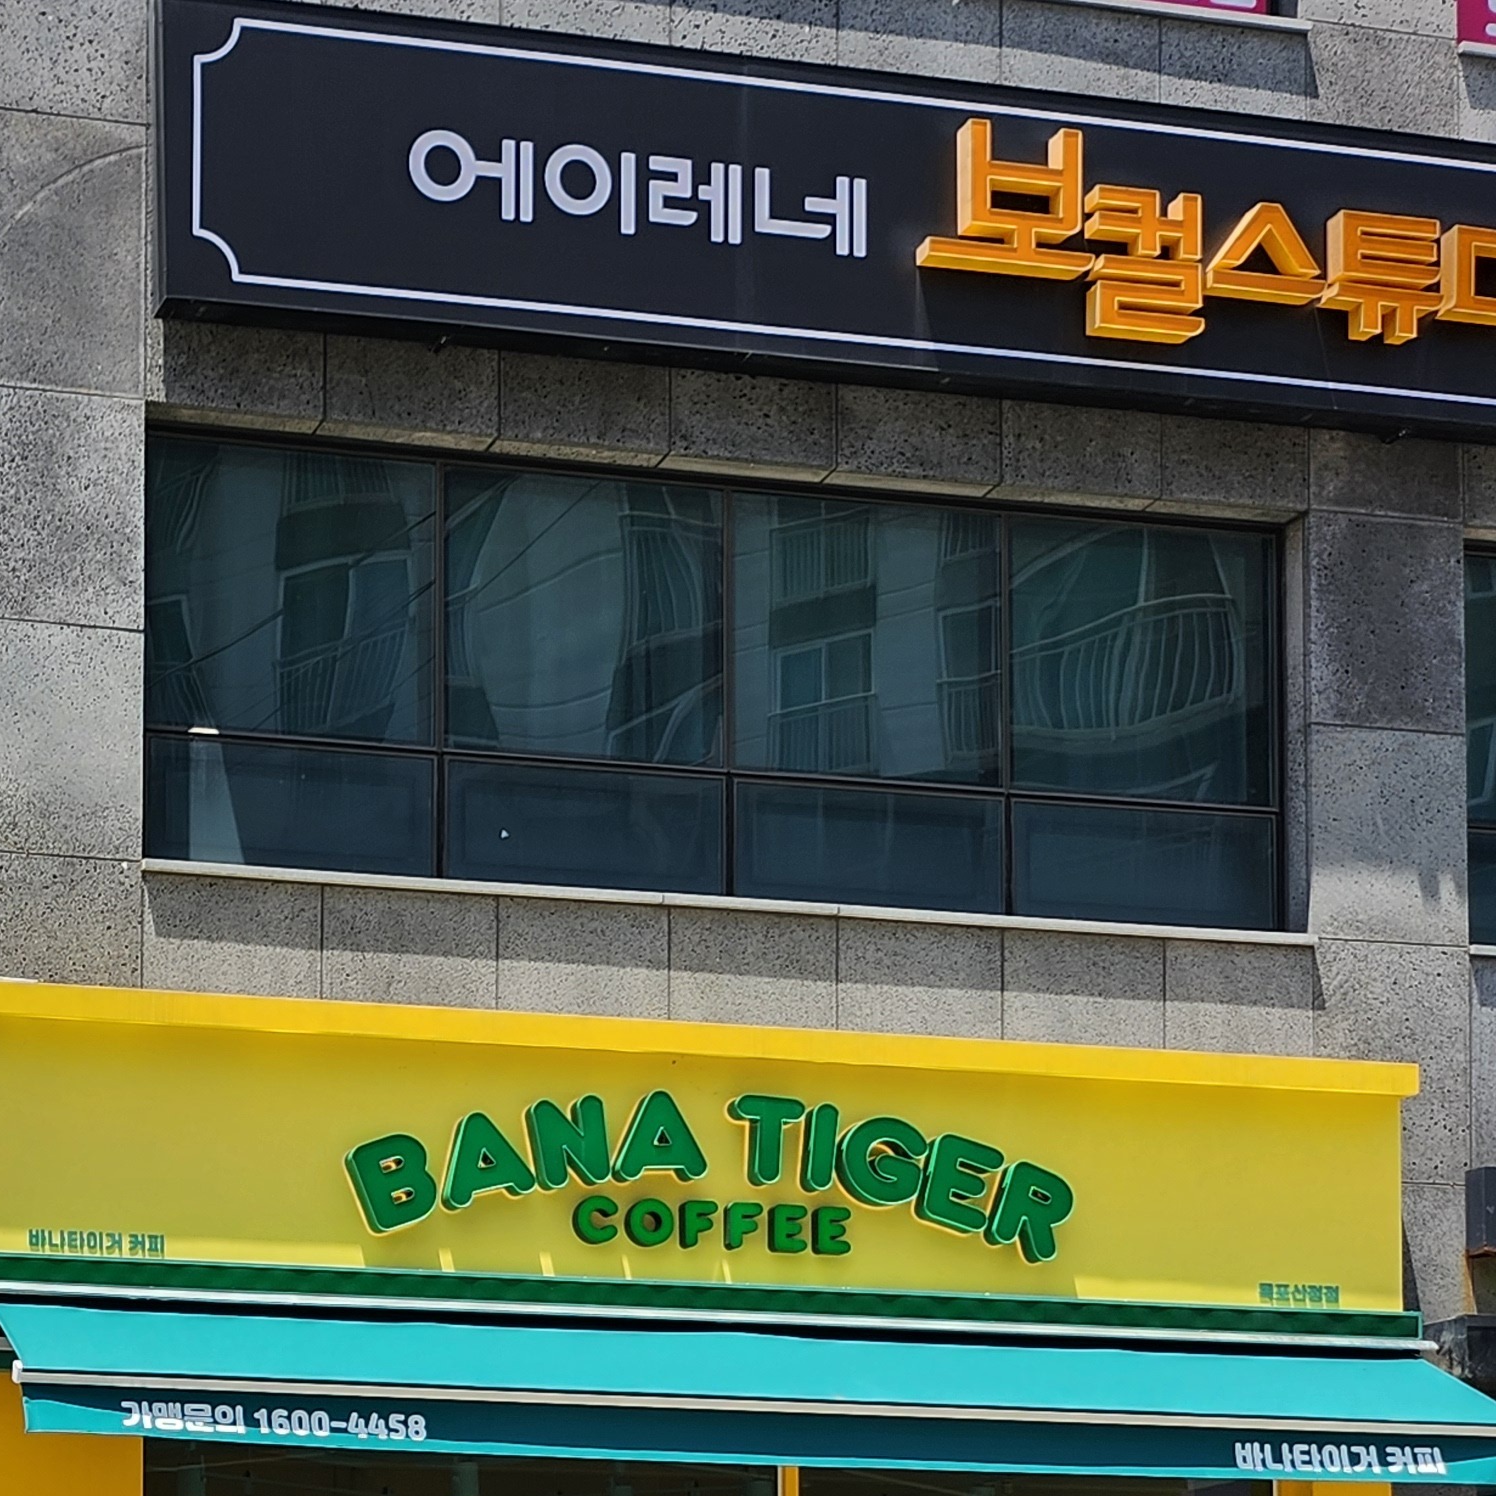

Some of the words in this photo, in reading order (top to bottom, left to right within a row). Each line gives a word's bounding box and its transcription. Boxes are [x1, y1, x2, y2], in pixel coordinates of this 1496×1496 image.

[409, 129, 868, 258] 에이레네
[344, 1089, 707, 1236] BANA
[726, 1093, 1074, 1264] TIGER
[28, 1229, 122, 1256] 바나타이거
[128, 1233, 165, 1257] 커피
[572, 1195, 853, 1255] COFFEE
[121, 1401, 244, 1435] 가맹문의
[253, 1408, 426, 1441] 1600-4458
[1234, 1442, 1380, 1474] 바나타이거
[1386, 1446, 1447, 1475] 커피
